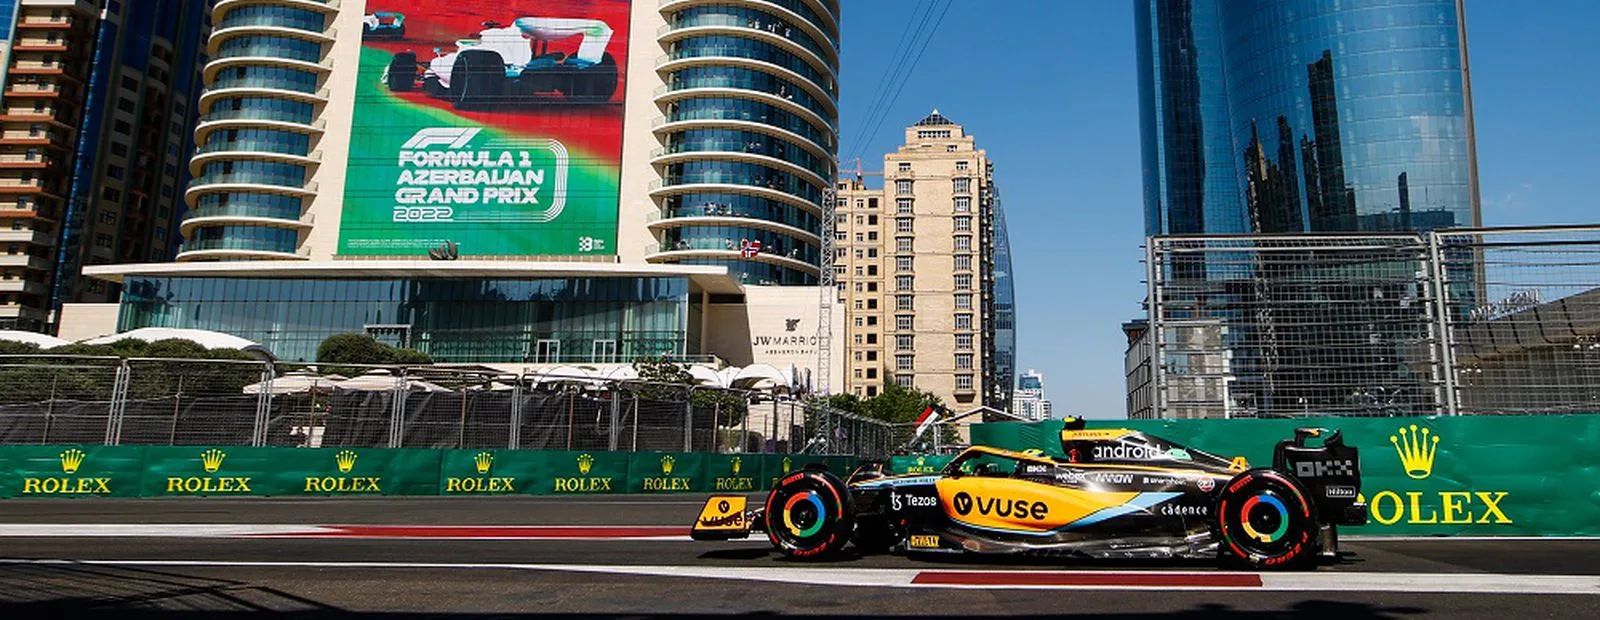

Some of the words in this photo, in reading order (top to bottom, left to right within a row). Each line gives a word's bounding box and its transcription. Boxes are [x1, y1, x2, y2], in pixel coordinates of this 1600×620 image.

[398, 151, 514, 167] FORMULA
[519, 151, 532, 167] 1
[397, 169, 544, 185] AZERBAIJAN
[395, 187, 479, 204] GRAND
[483, 187, 539, 204] PRIX
[393, 206, 454, 222] 2022
[753, 336, 771, 346] JW
[1091, 443, 1161, 459] android
[1296, 460, 1353, 477] OKX
[22, 478, 112, 494] ROLEX
[166, 477, 252, 492] ROLEX
[304, 477, 381, 492] ROLEX
[446, 478, 515, 492] ROLEX
[554, 479, 613, 492] ROLEX
[642, 479, 691, 491] ROLEX
[716, 477, 753, 490] ROLEX
[905, 494, 937, 507] Tezos
[975, 496, 1049, 520] vuse
[1356, 490, 1512, 525] OLEX
